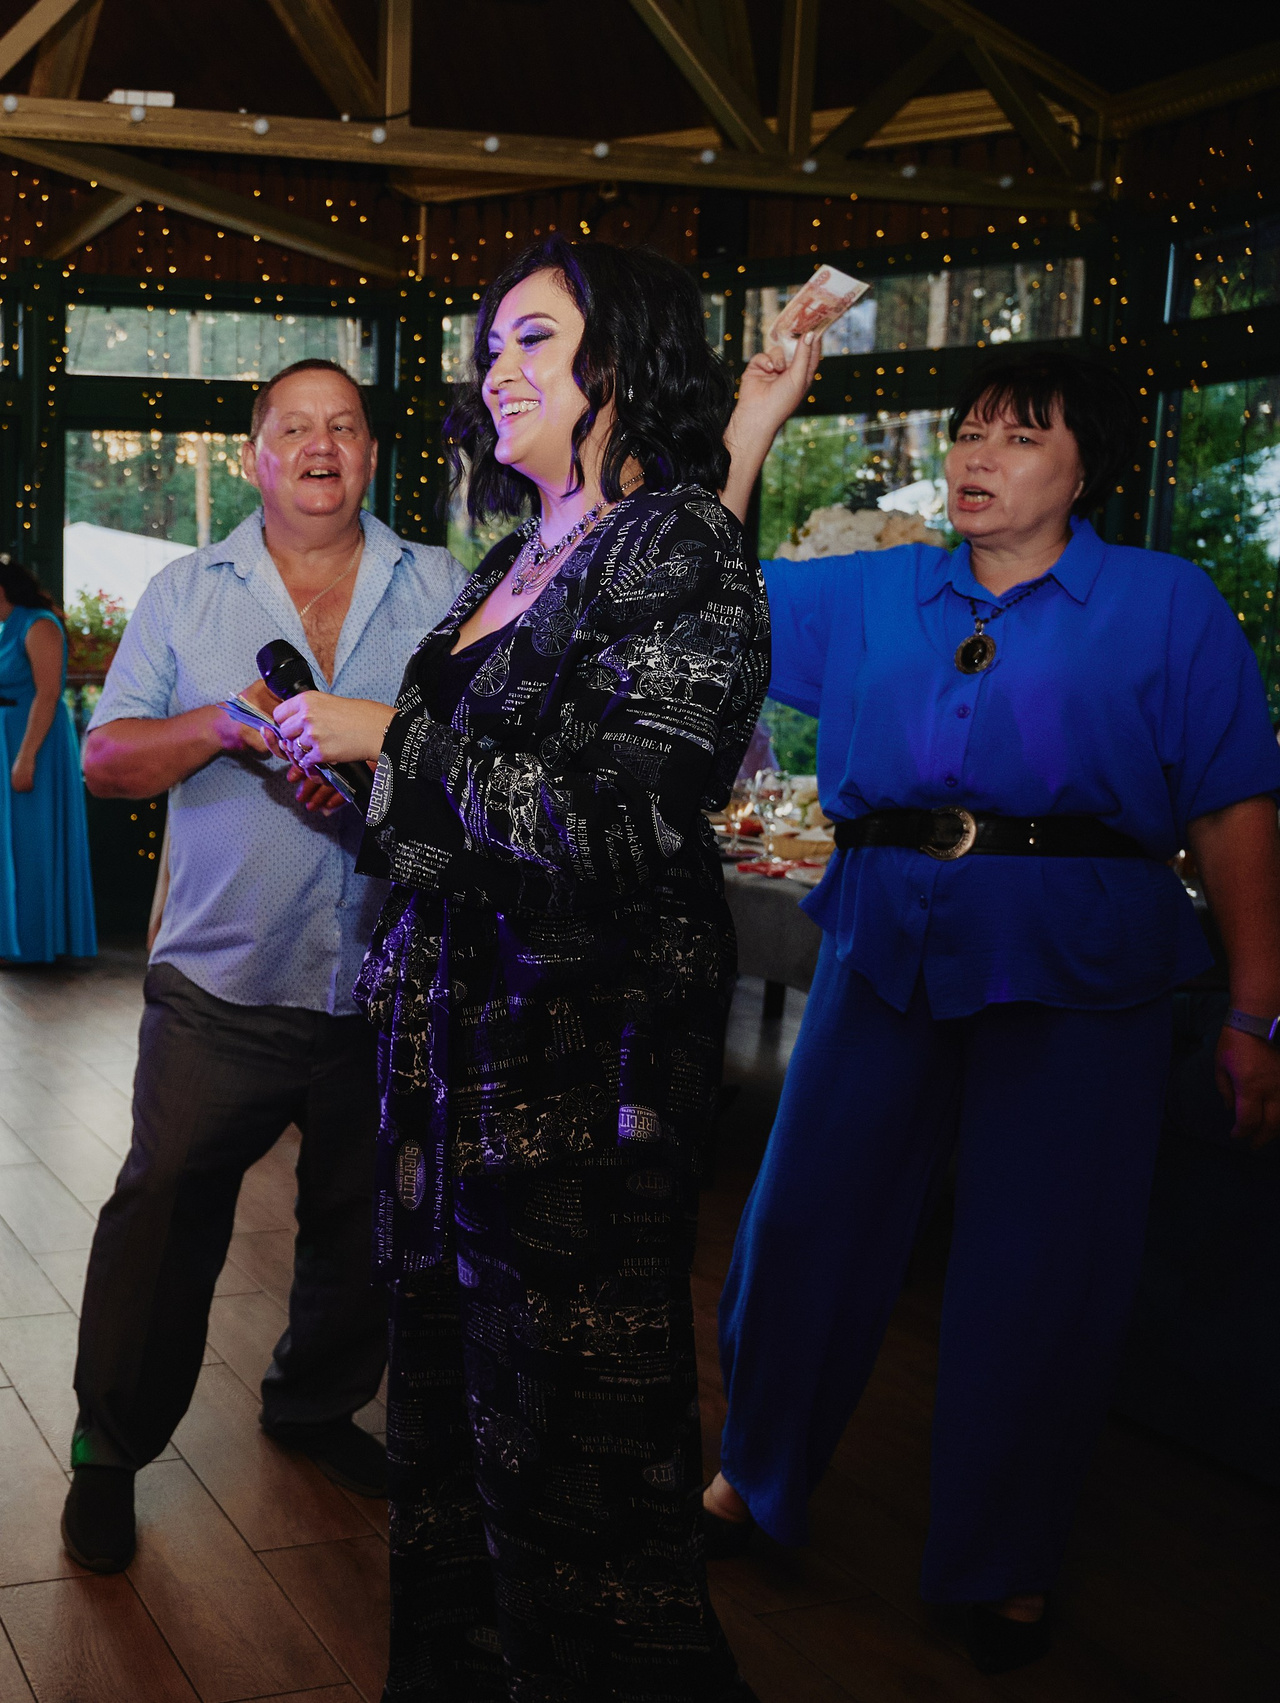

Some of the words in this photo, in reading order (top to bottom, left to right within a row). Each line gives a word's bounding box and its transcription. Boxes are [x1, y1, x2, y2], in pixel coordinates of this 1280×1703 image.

[602, 732, 672, 754] BEEBEEBEAR
[369, 761, 389, 820] SURFCITY
[403, 1145, 418, 1203] SURFCITY
